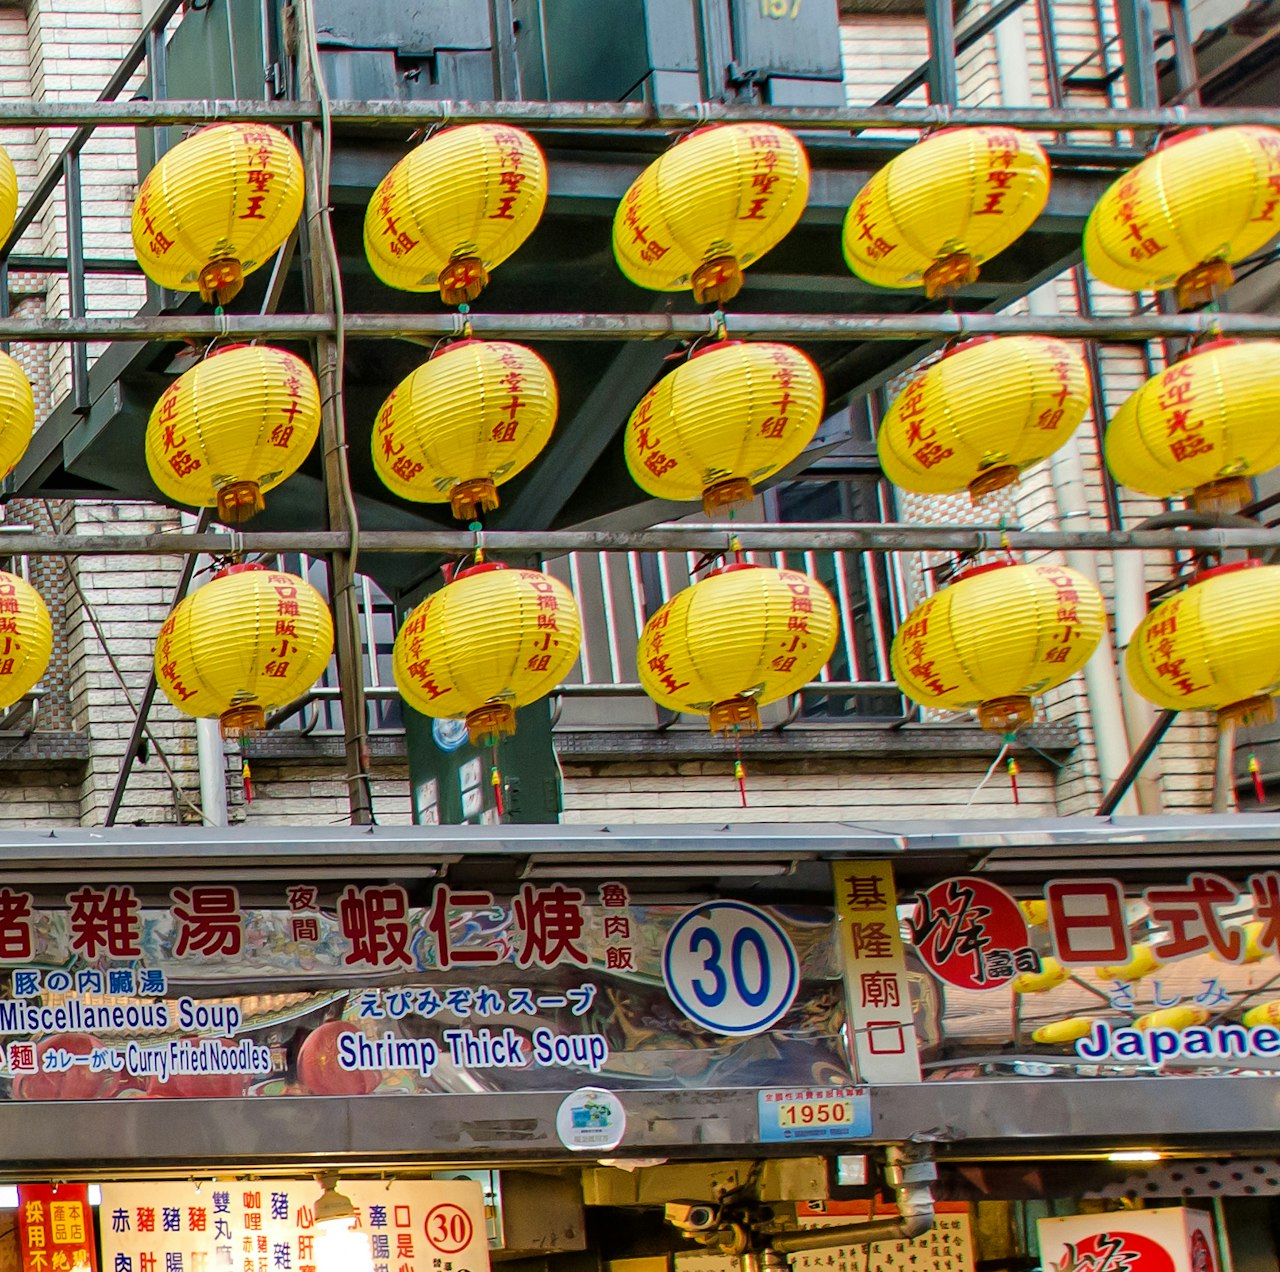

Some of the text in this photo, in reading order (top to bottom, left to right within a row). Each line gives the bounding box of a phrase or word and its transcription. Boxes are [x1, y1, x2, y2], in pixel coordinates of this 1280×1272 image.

[239, 135, 275, 221] 開漳聖王
[405, 615, 452, 701] 開漳聖王
[904, 614, 959, 697] 開漳聖王
[1147, 614, 1204, 697] 開漳聖王
[289, 887, 318, 942] 夜間
[602, 884, 633, 969] 魯肉飯
[689, 927, 770, 1009] 30
[848, 875, 906, 1055] 基隆廟口
[1109, 977, 1231, 1010] さしみ
[0, 1001, 167, 1031] Miscellaneous
[179, 1000, 239, 1034] Soup
[339, 1030, 607, 1075] Shrimp Thick Soup
[786, 1103, 845, 1124] 1950
[433, 1213, 466, 1244] 30
